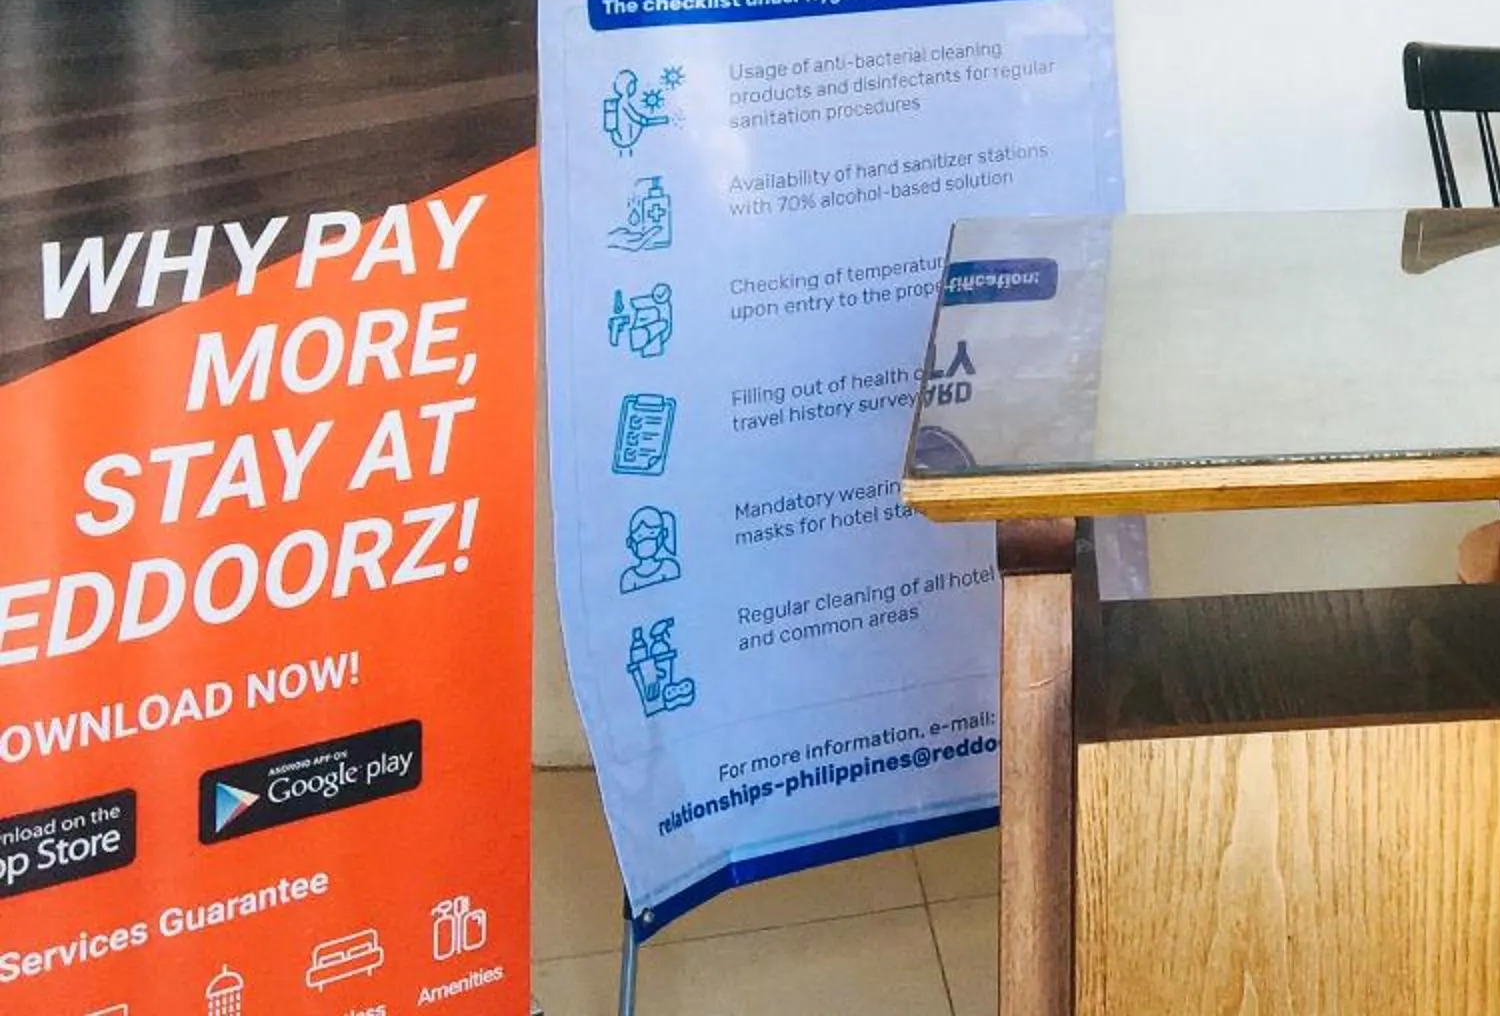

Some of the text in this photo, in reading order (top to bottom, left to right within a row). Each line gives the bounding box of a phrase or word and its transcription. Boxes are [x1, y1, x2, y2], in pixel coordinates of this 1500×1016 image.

[729, 41, 1003, 82] Usage of anti-bacterial cleaning
[729, 59, 1056, 105] products and disinfectants for regular
[730, 98, 921, 130] sanitation procedures
[729, 144, 1050, 194] Availability of hand sanitizer stations
[729, 170, 1014, 217] with 70% alcohol-based solution
[41, 194, 488, 321] WHY PAY
[730, 256, 945, 295] Checking of temperatur
[731, 303, 778, 322] upon
[784, 295, 835, 314] entry
[839, 293, 857, 308] to
[862, 287, 891, 303] the
[185, 297, 478, 412] MORE,
[731, 386, 786, 407] Filling
[791, 379, 823, 398] out
[827, 375, 847, 394] of
[851, 368, 909, 391] health
[733, 408, 784, 432] travel
[789, 399, 854, 424] history
[74, 397, 477, 537] STAY AT
[735, 479, 902, 520] Mandatory wearin
[735, 503, 915, 546] masks for hotel sta
[737, 565, 996, 625] Regular cleaning of all hotel
[739, 606, 919, 652] and common areas
[0, 650, 360, 764] OWNLOAD NOW!
[719, 761, 748, 782] For
[751, 748, 801, 773] more
[929, 711, 995, 735] e-mail:
[267, 751, 413, 803] Google play
[658, 735, 999, 837] relationships-philippines@reddo
[0, 805, 121, 846] nload on the
[37, 829, 121, 870] Store
[0, 872, 329, 983] Services Guarantee
[417, 965, 504, 1007] Amenities
